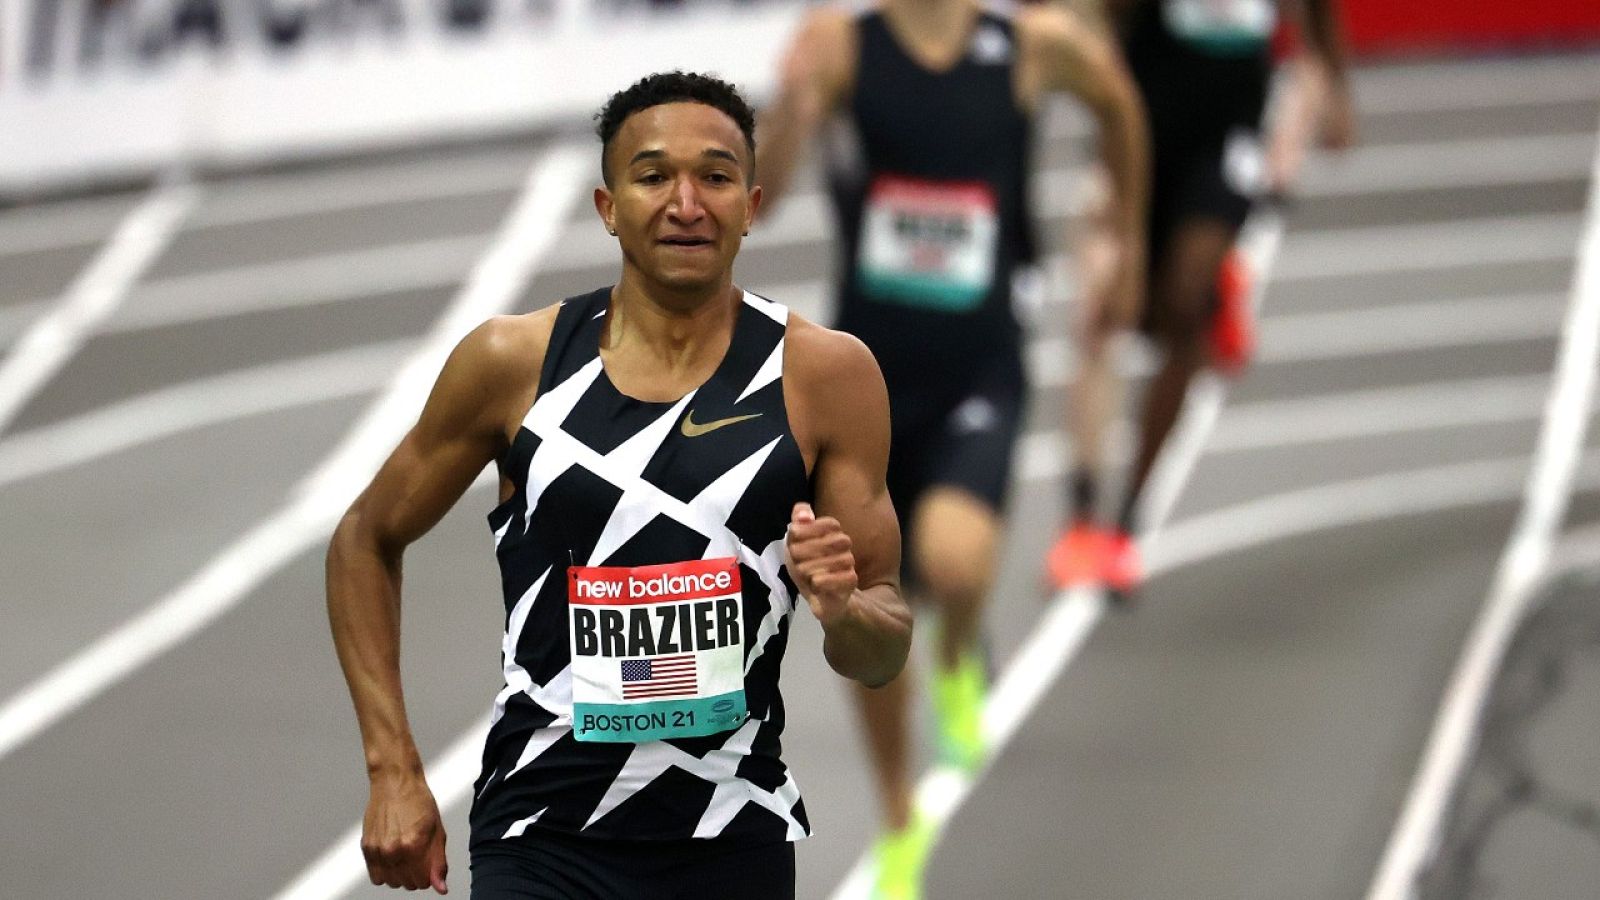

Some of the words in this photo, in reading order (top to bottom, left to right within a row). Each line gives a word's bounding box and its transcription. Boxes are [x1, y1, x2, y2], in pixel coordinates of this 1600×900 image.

[577, 579, 622, 598] new
[629, 570, 732, 598] balance
[573, 598, 740, 658] BRAZIER
[583, 712, 666, 732] BOSTON
[672, 711, 695, 728] 21
